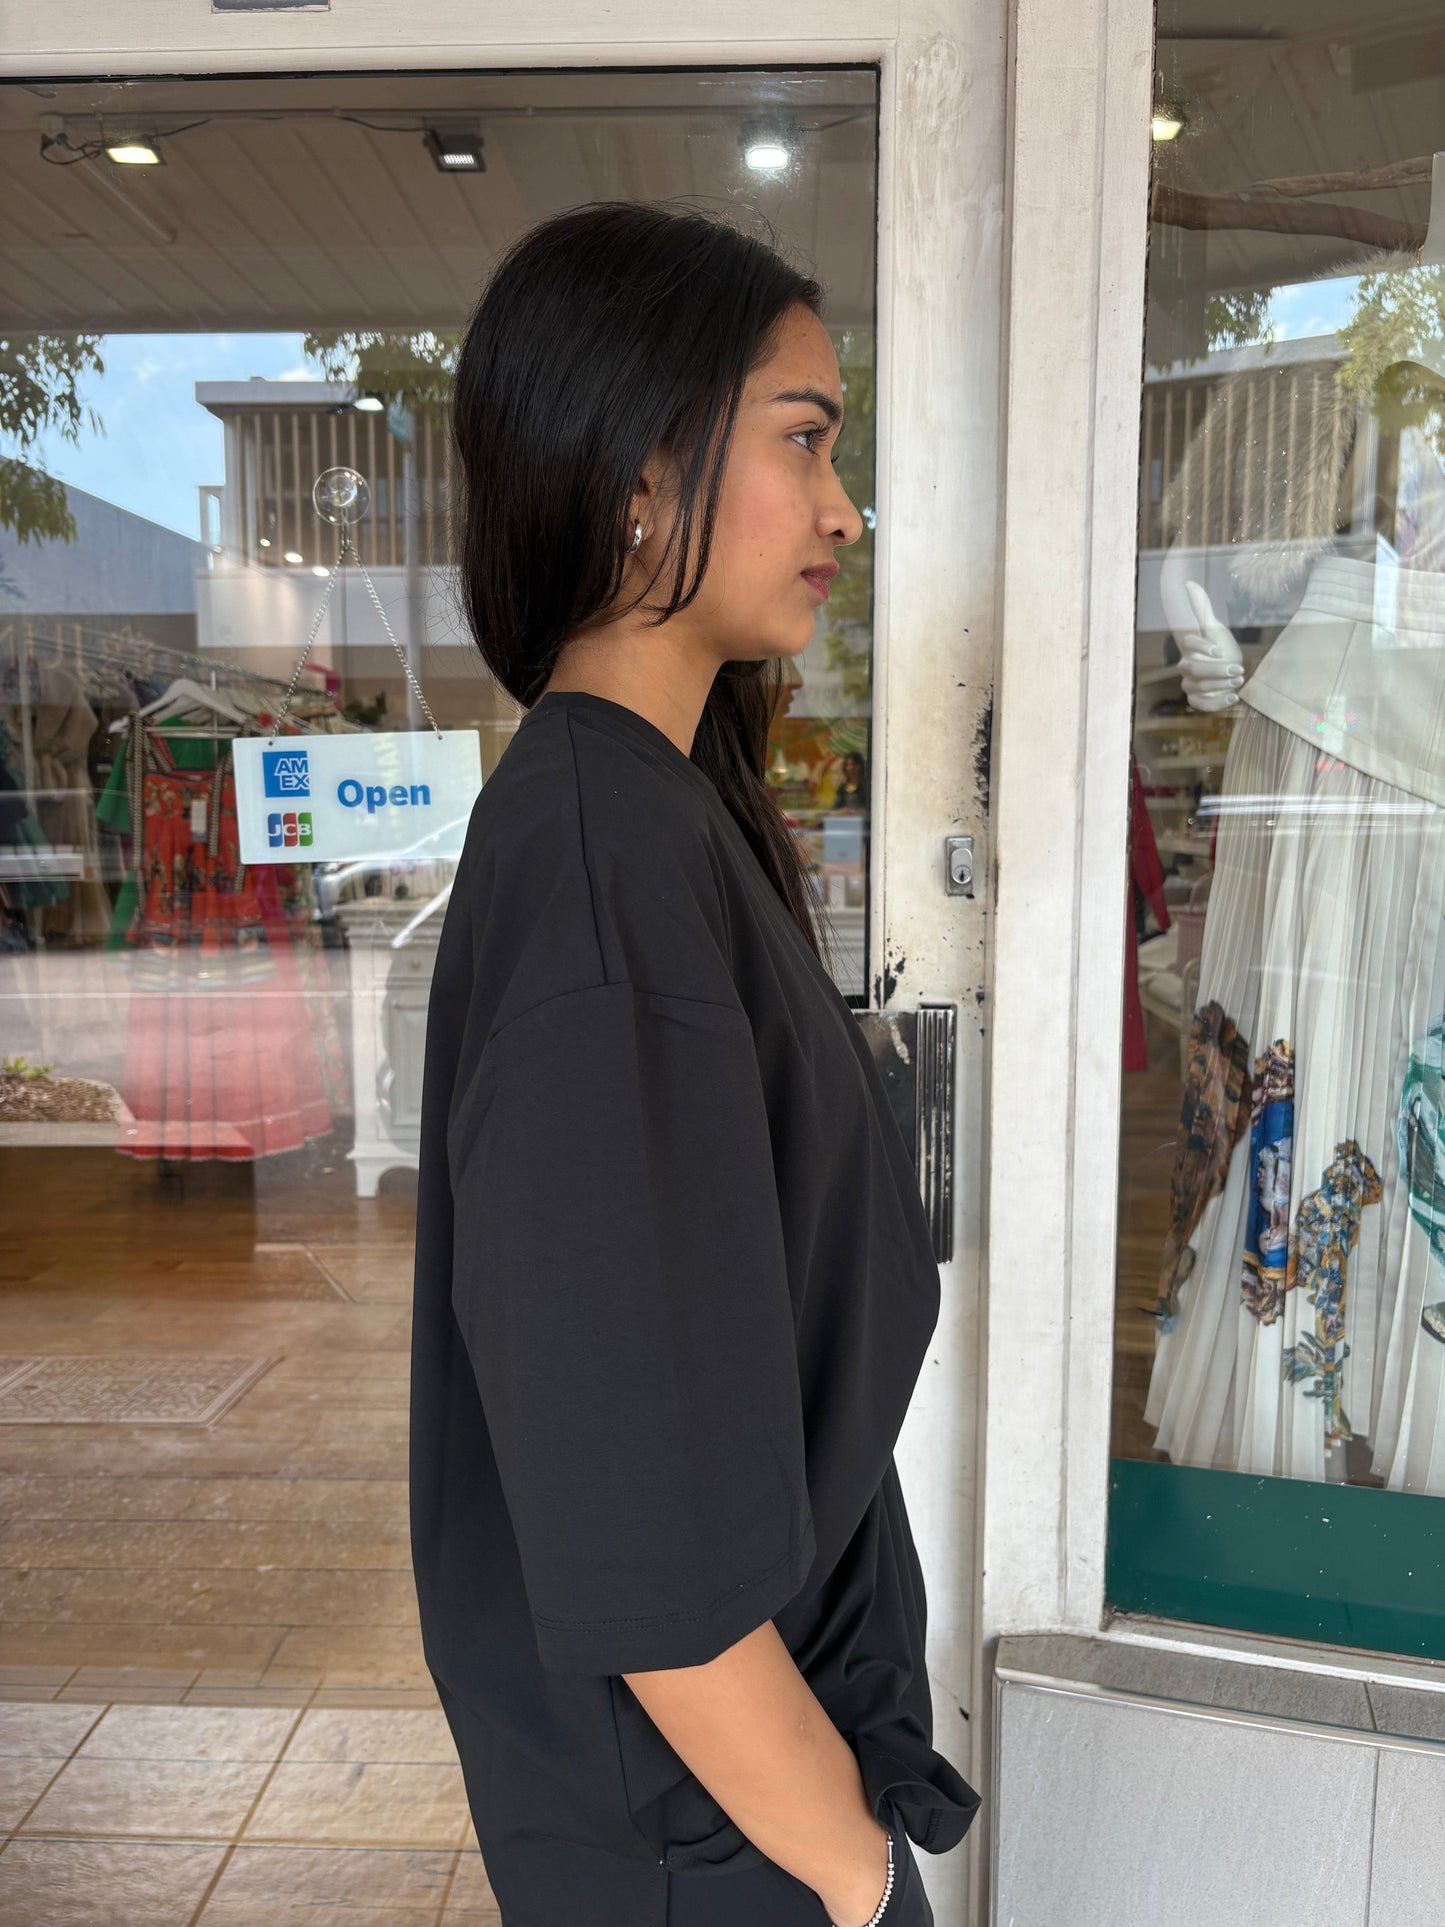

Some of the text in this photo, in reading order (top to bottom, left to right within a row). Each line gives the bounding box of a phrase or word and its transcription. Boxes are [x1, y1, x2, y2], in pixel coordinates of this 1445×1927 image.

[274, 757, 309, 775] AM
[279, 773, 310, 791] EX
[337, 779, 431, 814] Open
